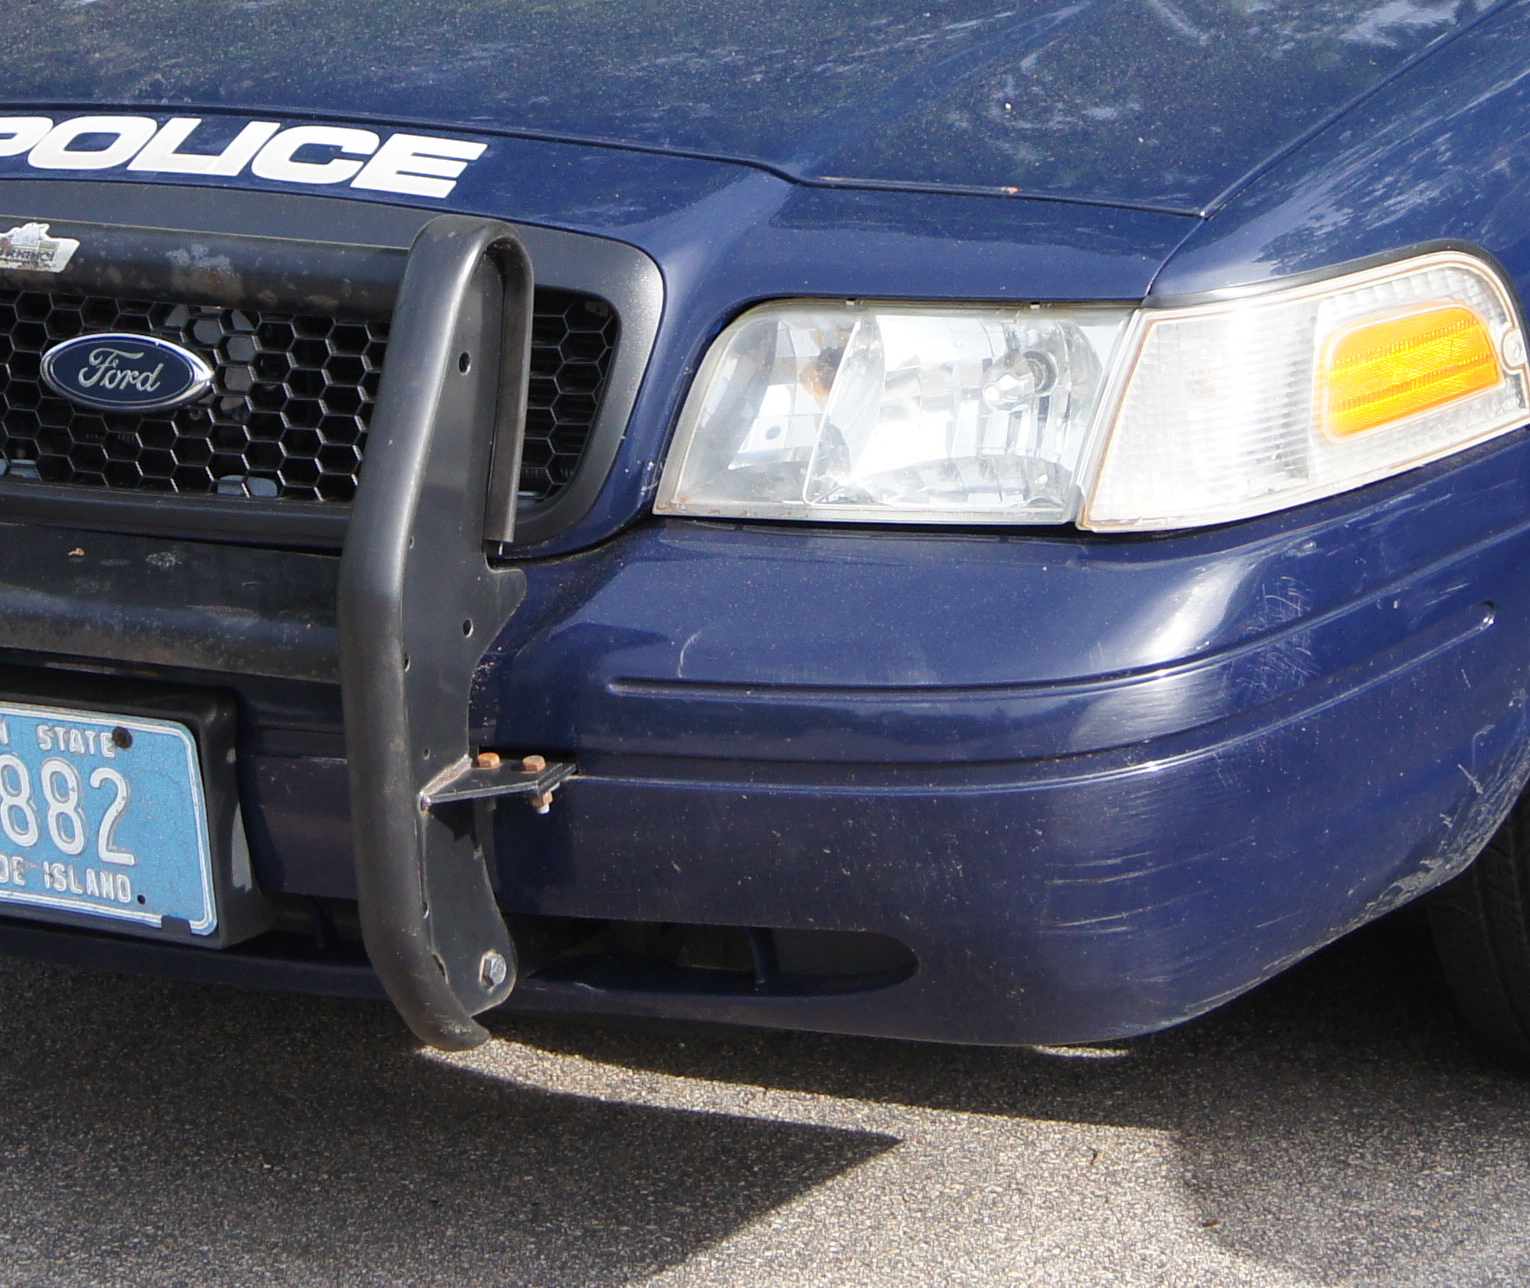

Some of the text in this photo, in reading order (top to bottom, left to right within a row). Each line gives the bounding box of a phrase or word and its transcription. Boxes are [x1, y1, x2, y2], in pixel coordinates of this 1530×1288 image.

[78, 347, 161, 394] Ford
[36, 724, 117, 758] STATE
[42, 862, 132, 904] ISLAND
